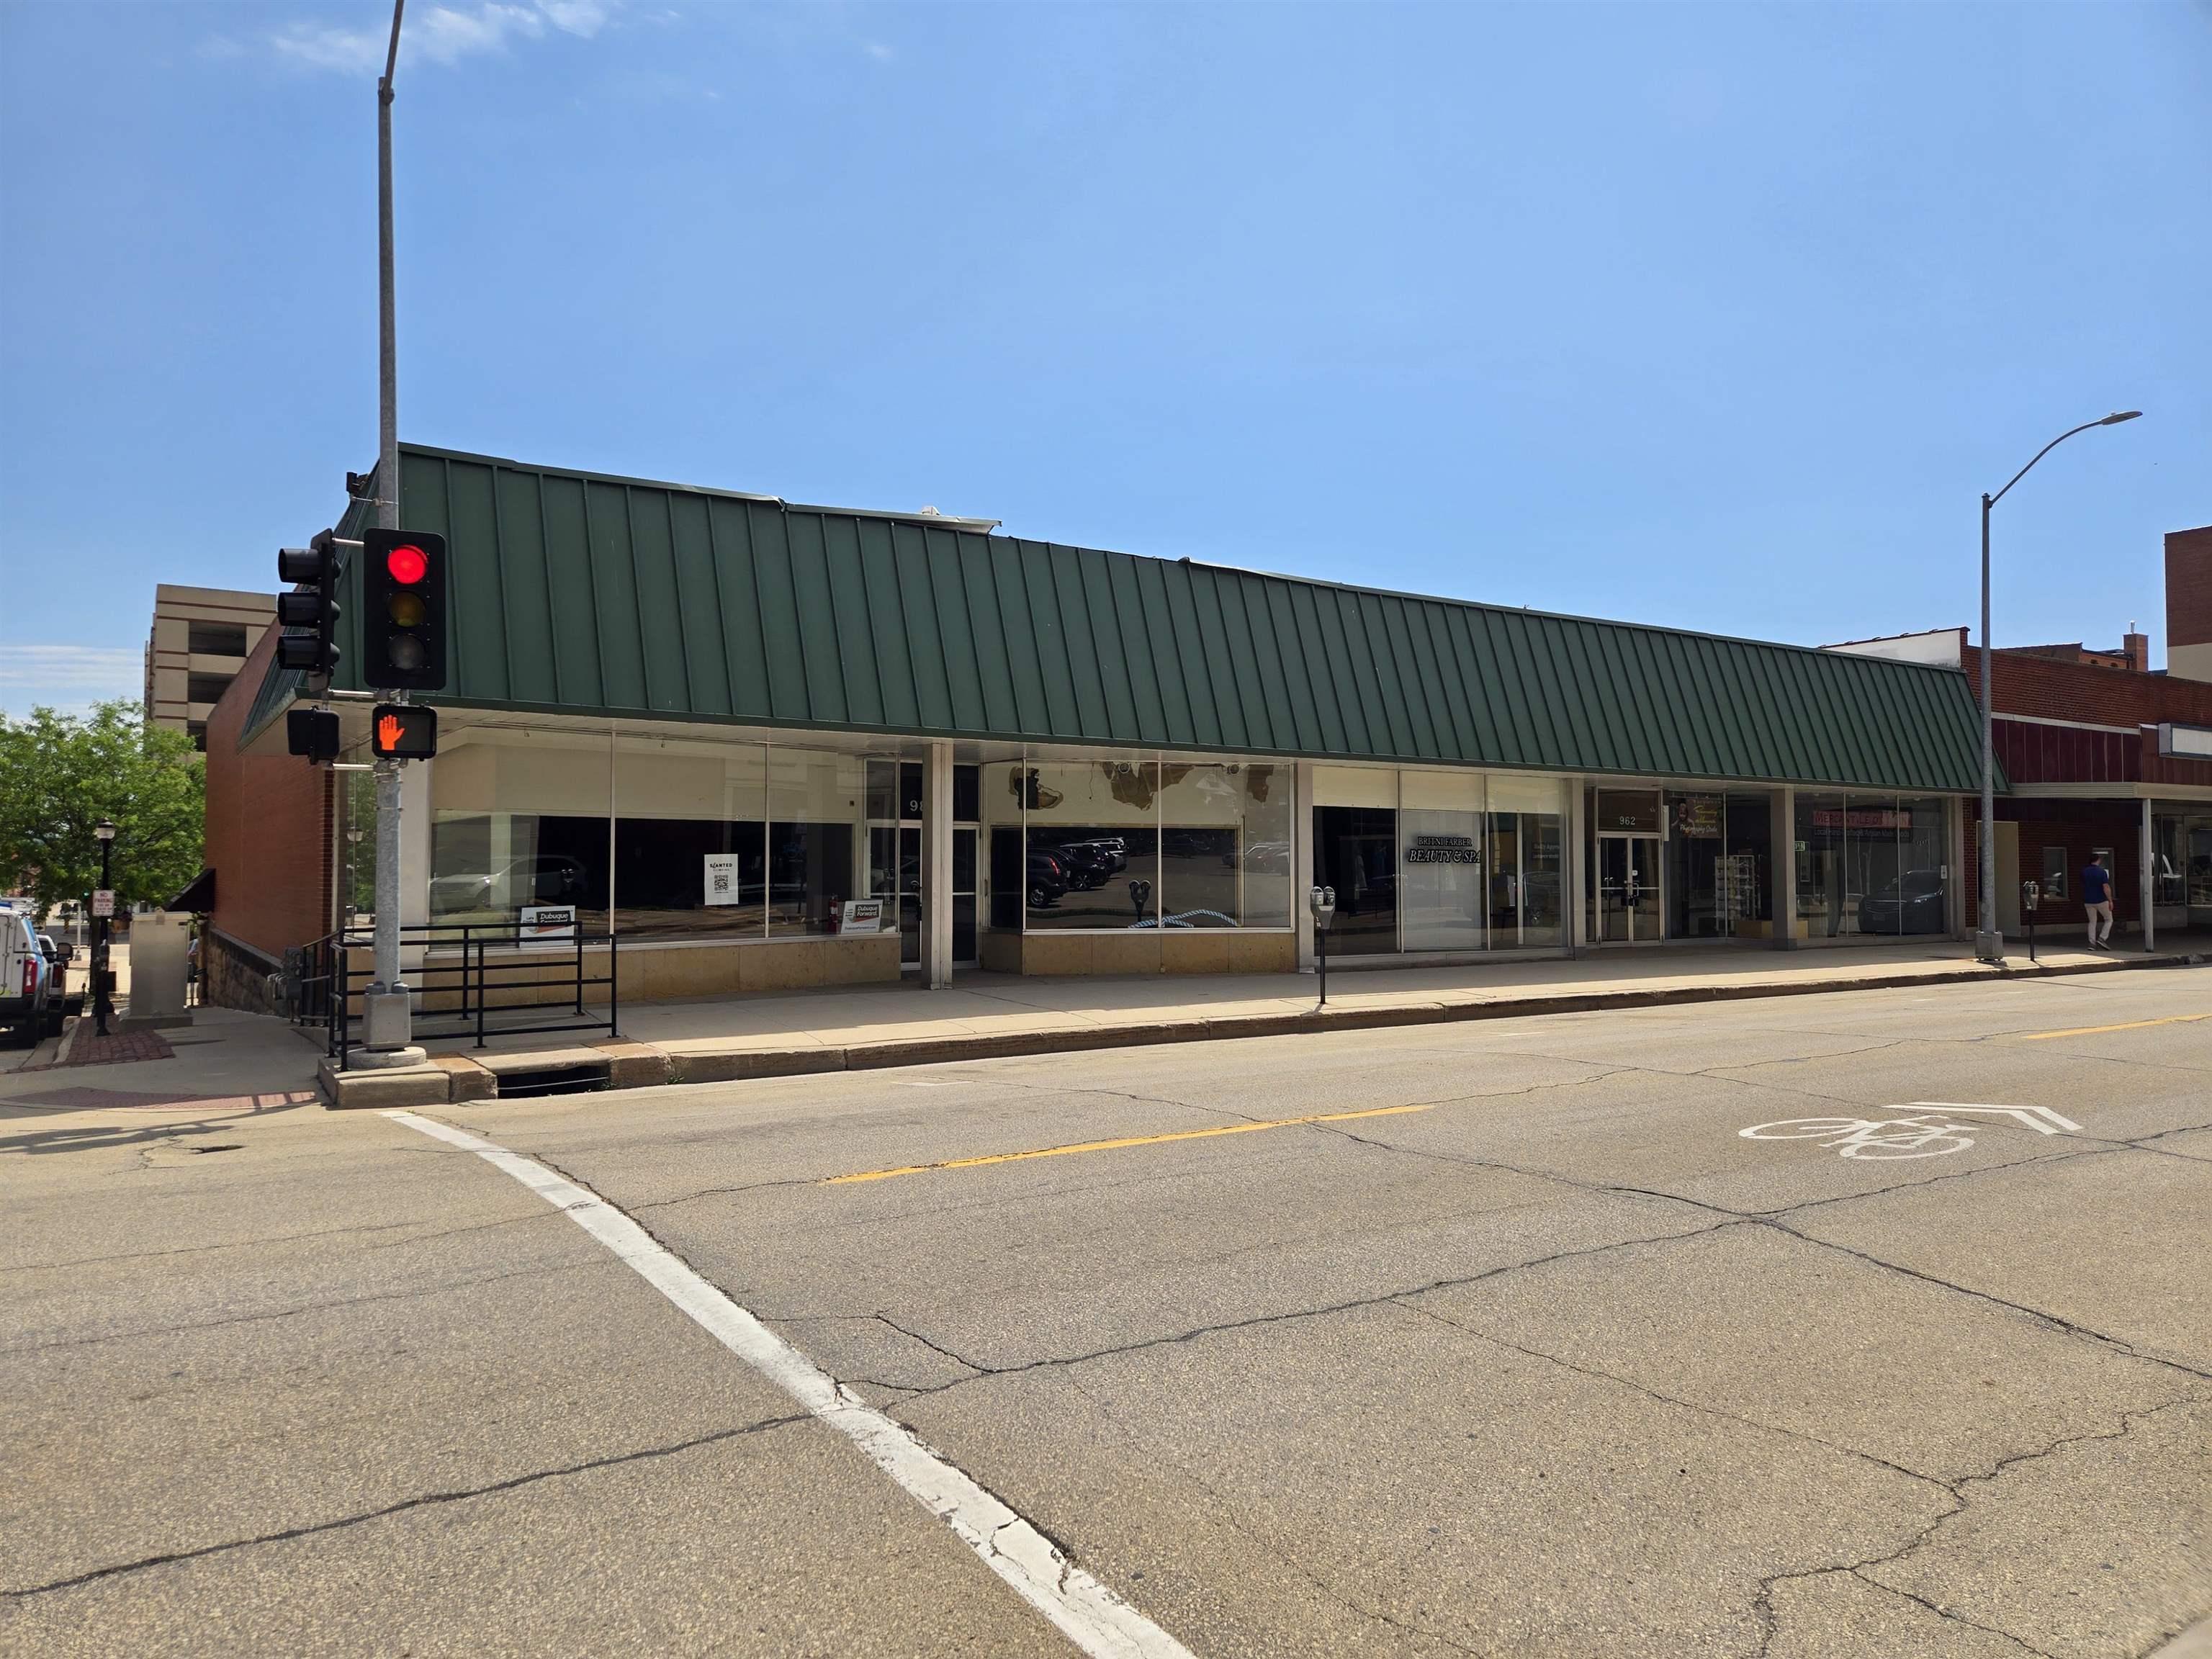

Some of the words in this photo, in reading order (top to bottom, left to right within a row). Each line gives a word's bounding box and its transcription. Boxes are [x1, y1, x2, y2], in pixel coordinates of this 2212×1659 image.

[1619, 816, 1636, 825] 962
[1417, 836, 1444, 846] BRITNI
[1444, 837, 1473, 846] FARBER
[1409, 850, 1452, 863] BEAUTY
[1453, 850, 1462, 863] &
[1462, 850, 1481, 863] SPA
